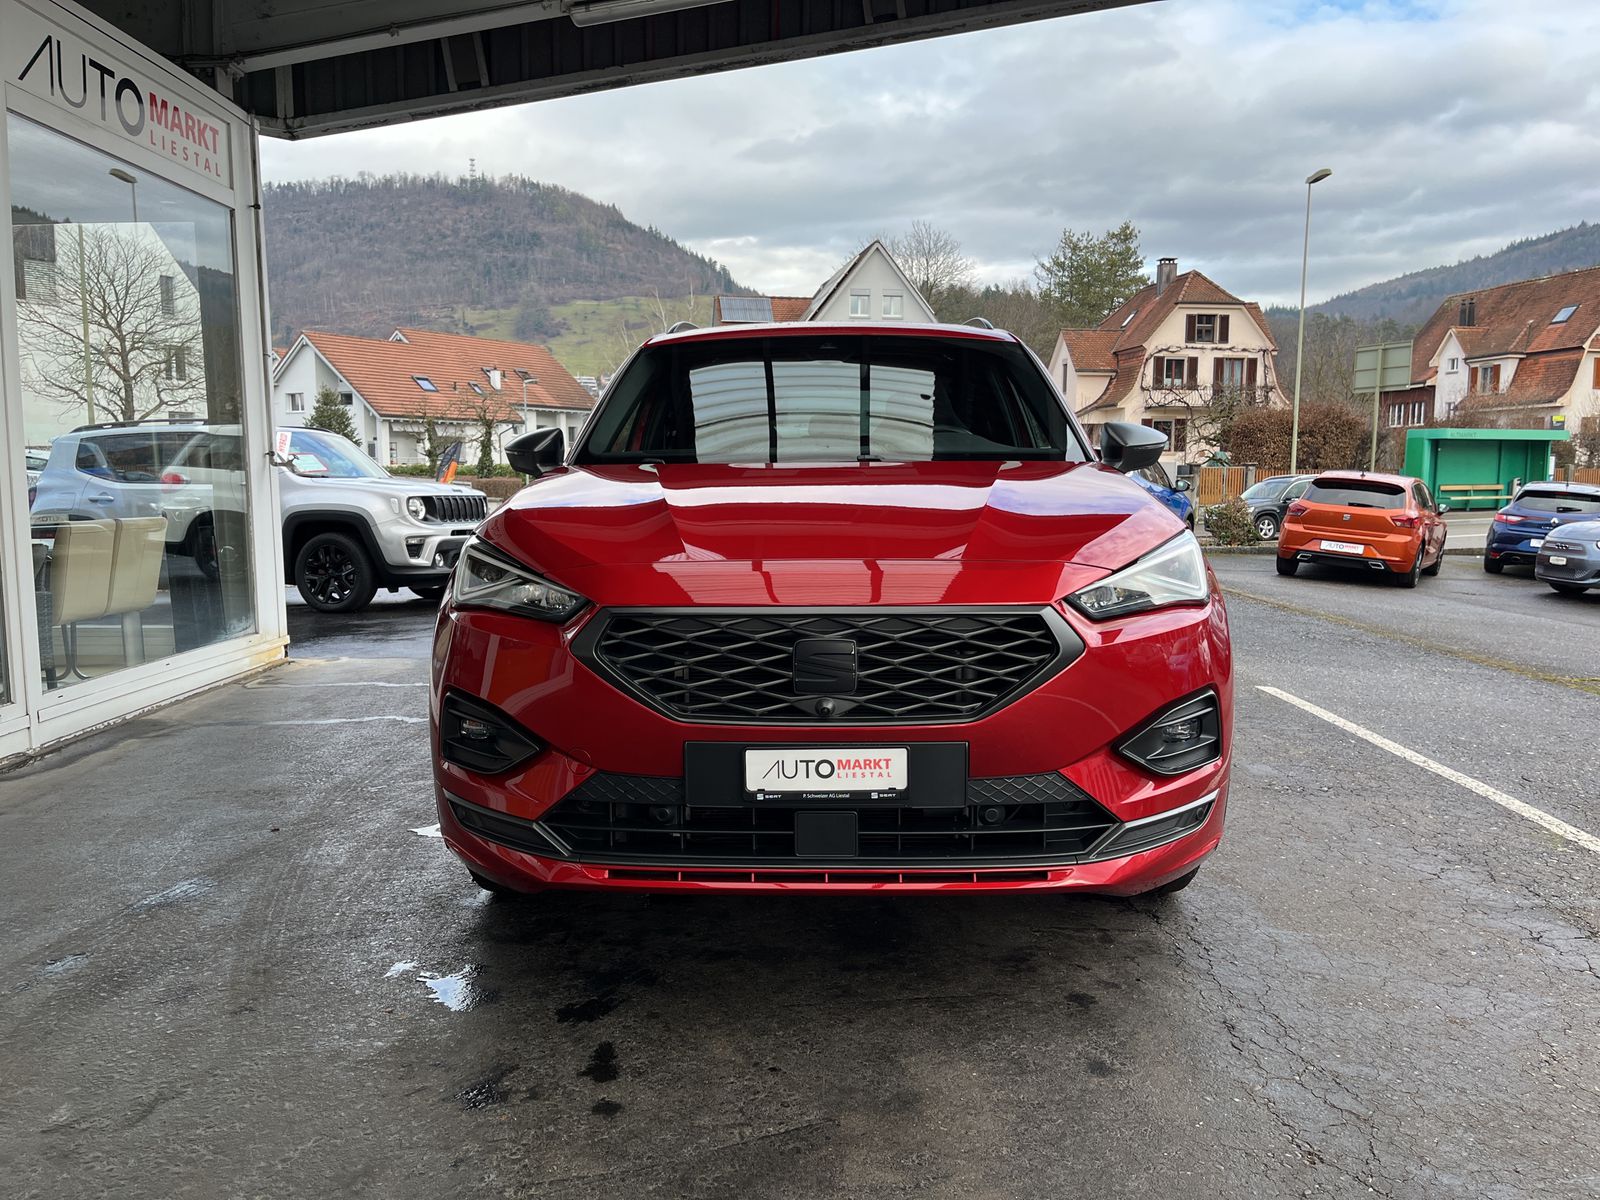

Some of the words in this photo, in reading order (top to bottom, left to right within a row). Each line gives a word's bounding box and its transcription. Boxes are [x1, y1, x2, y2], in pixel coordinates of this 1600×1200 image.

[18, 34, 146, 137] AUTO
[149, 91, 220, 155] MARKT
[150, 130, 222, 178] LIESTAL
[762, 759, 835, 779] AUTO
[837, 758, 892, 770] MARKT
[837, 771, 892, 779] LIESTAL
